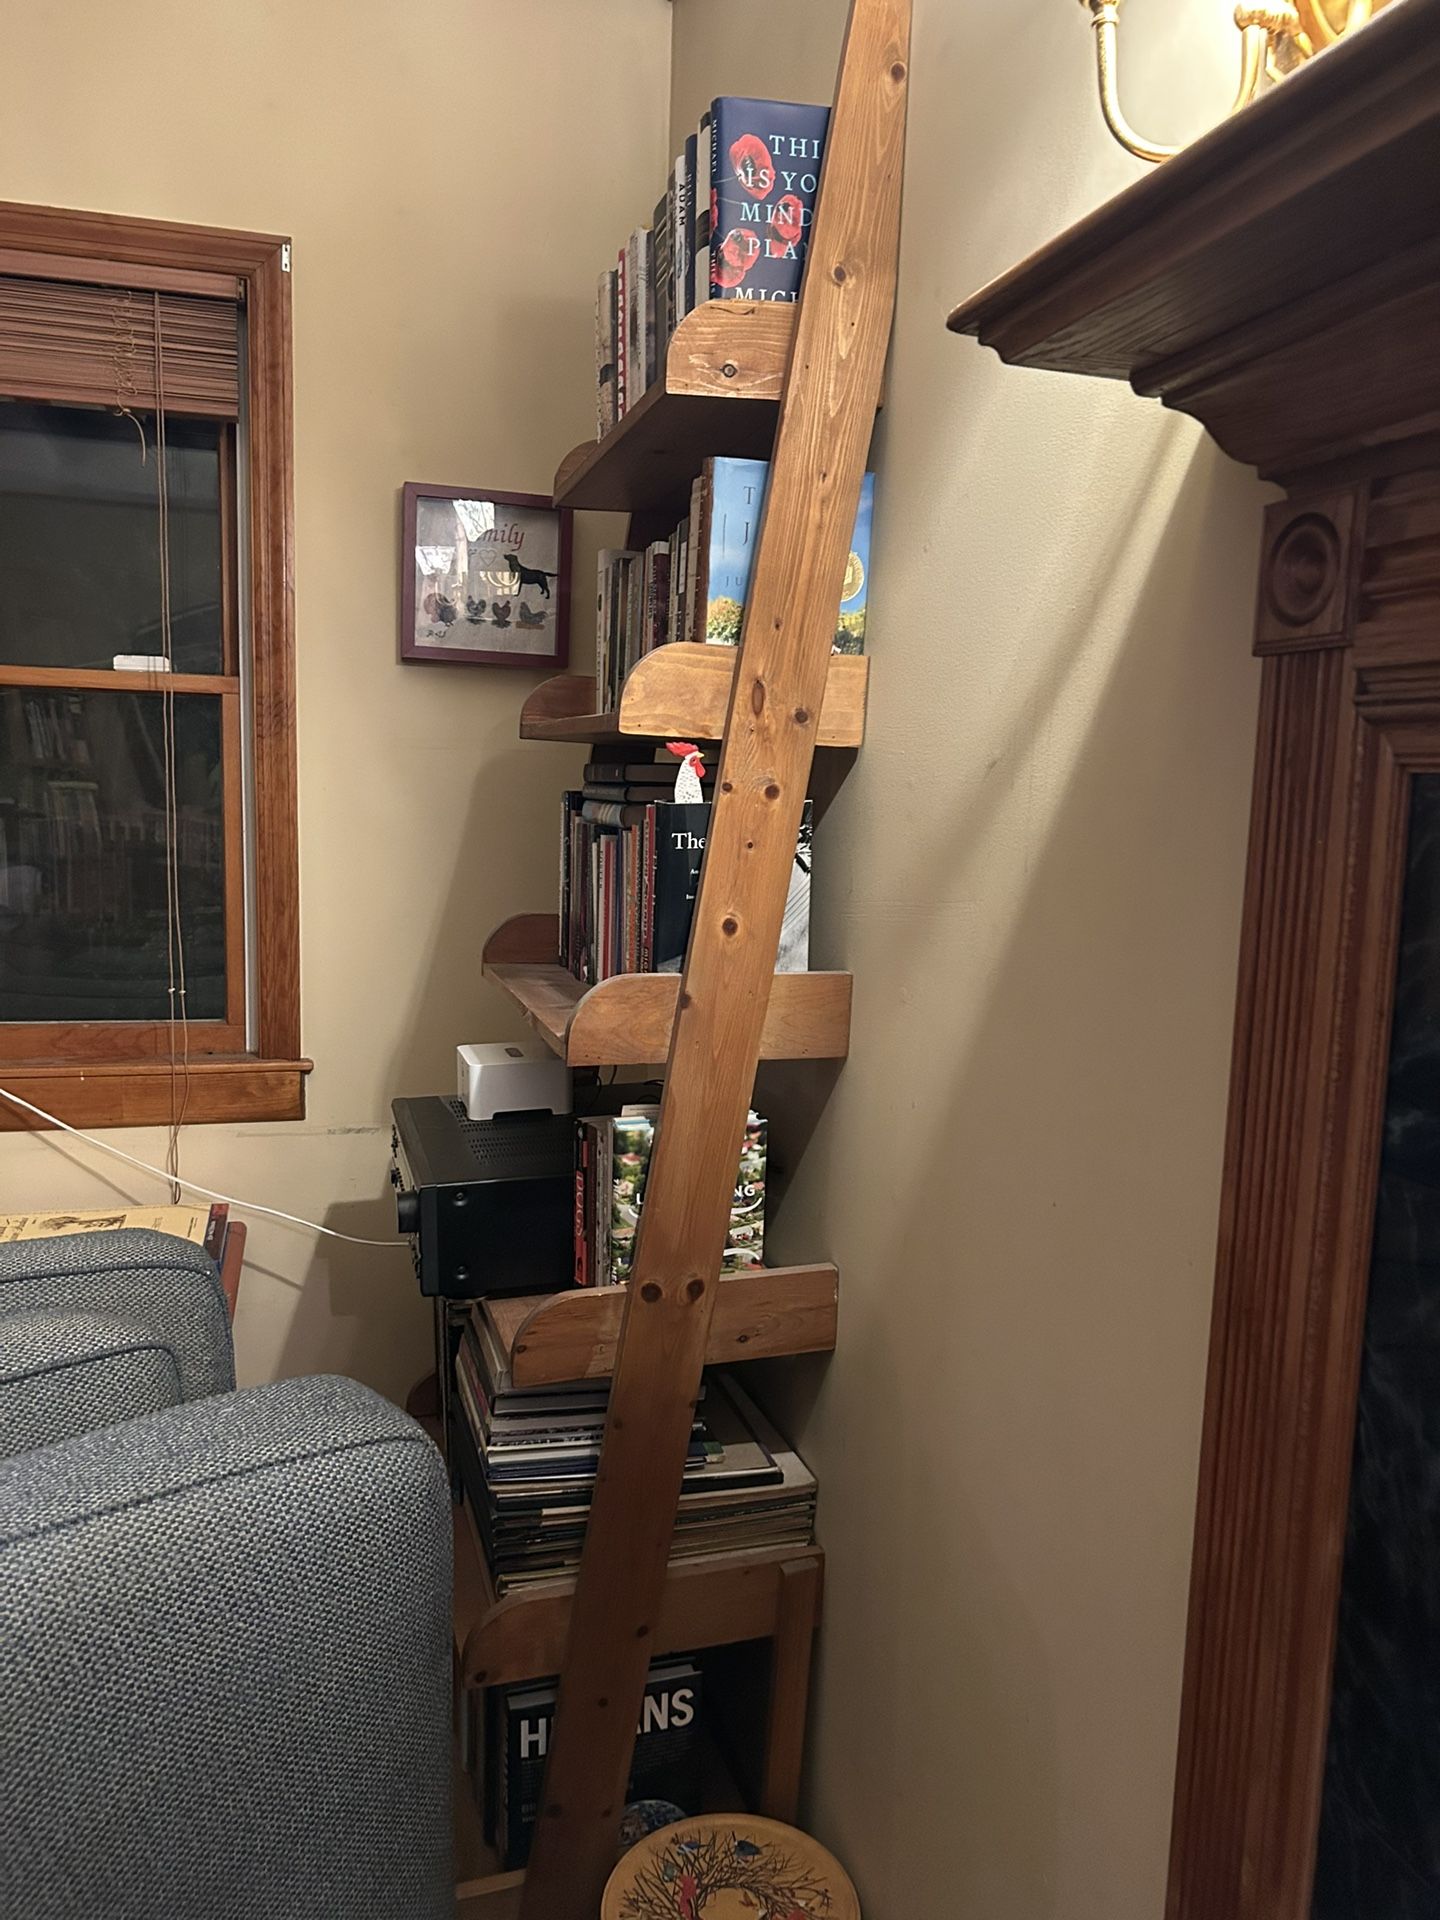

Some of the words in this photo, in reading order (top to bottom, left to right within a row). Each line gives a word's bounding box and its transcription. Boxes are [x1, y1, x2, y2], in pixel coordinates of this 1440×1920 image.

[769, 135, 820, 158] THI
[746, 167, 770, 188] IS
[781, 171, 817, 193] YO
[679, 184, 687, 226] ADAM
[747, 238, 800, 260] PLA
[482, 523, 525, 552] mily
[671, 831, 706, 850] The
